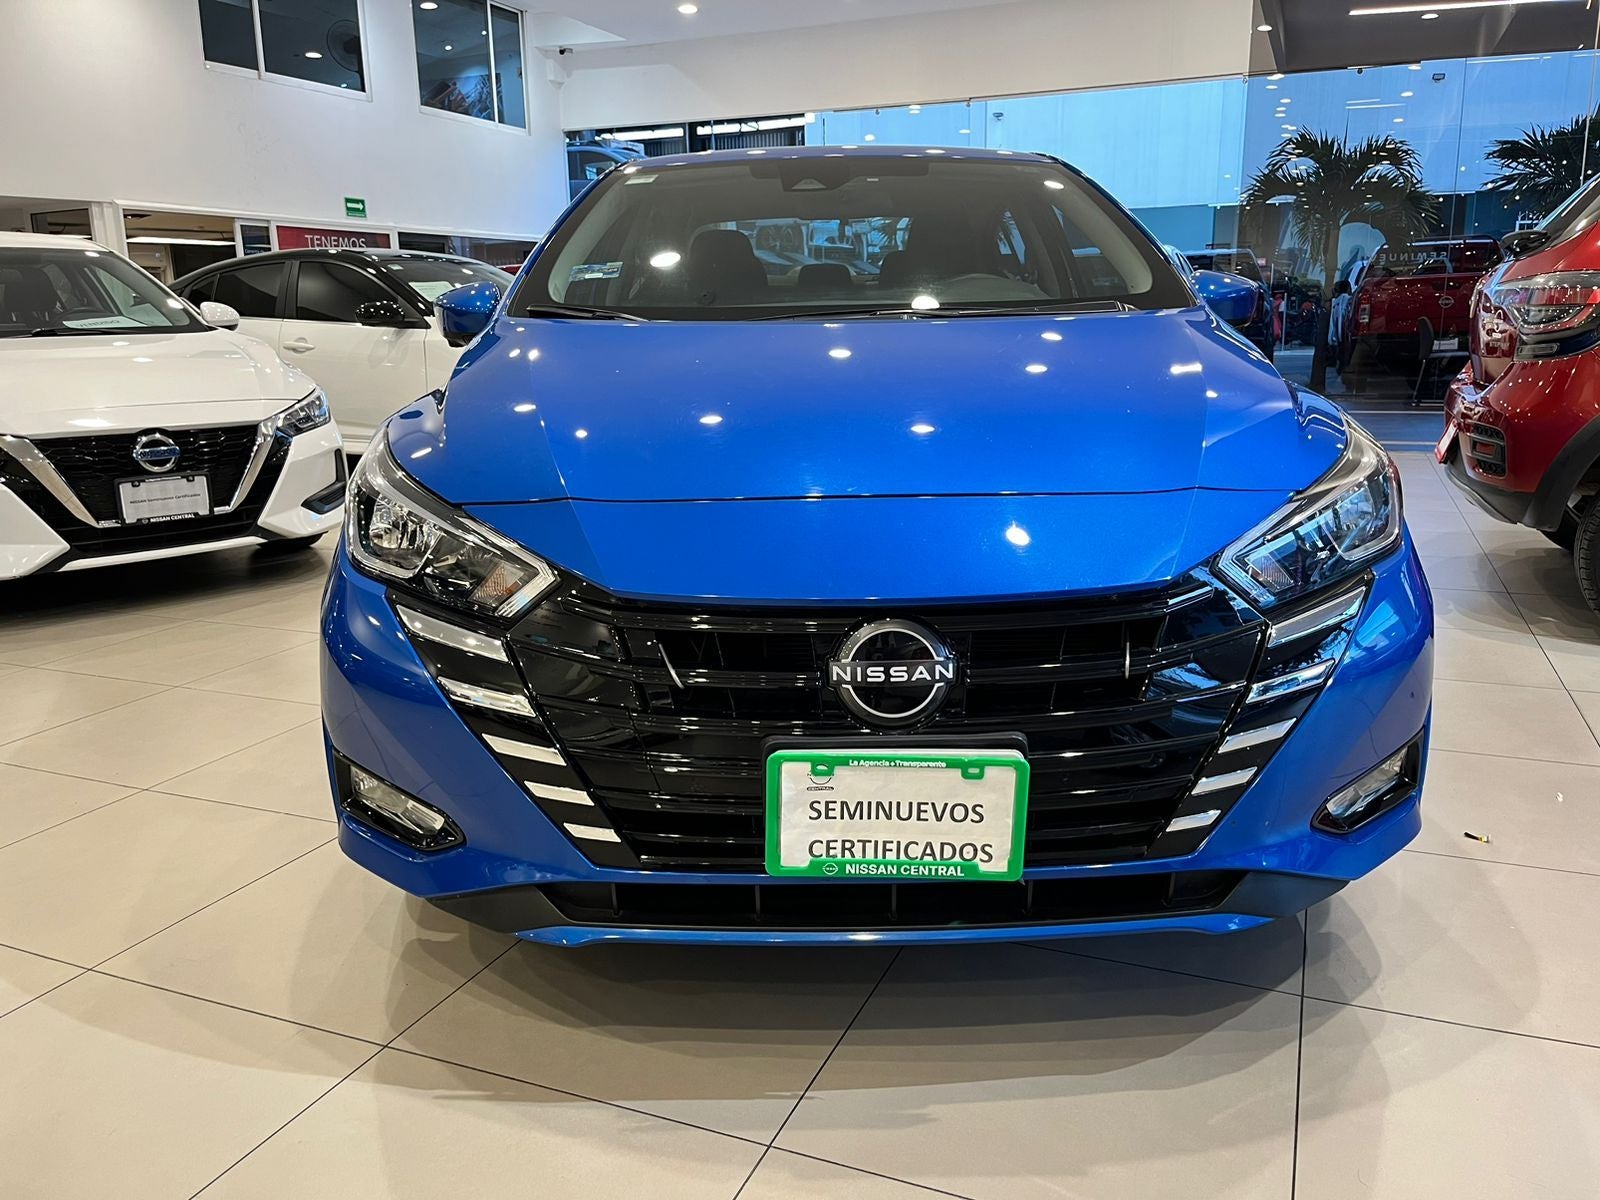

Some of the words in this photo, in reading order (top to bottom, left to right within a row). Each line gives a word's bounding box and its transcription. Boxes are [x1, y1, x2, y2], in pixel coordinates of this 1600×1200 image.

[304, 234, 366, 249] TENEMOS
[171, 513, 195, 521] CENTRAL
[832, 663, 953, 682] NISSAN
[808, 800, 985, 824] SEMINUEVOS
[808, 839, 994, 863] CERTIFICADOS
[845, 864, 897, 875] NISSAN
[900, 864, 965, 877] CENTRAL
